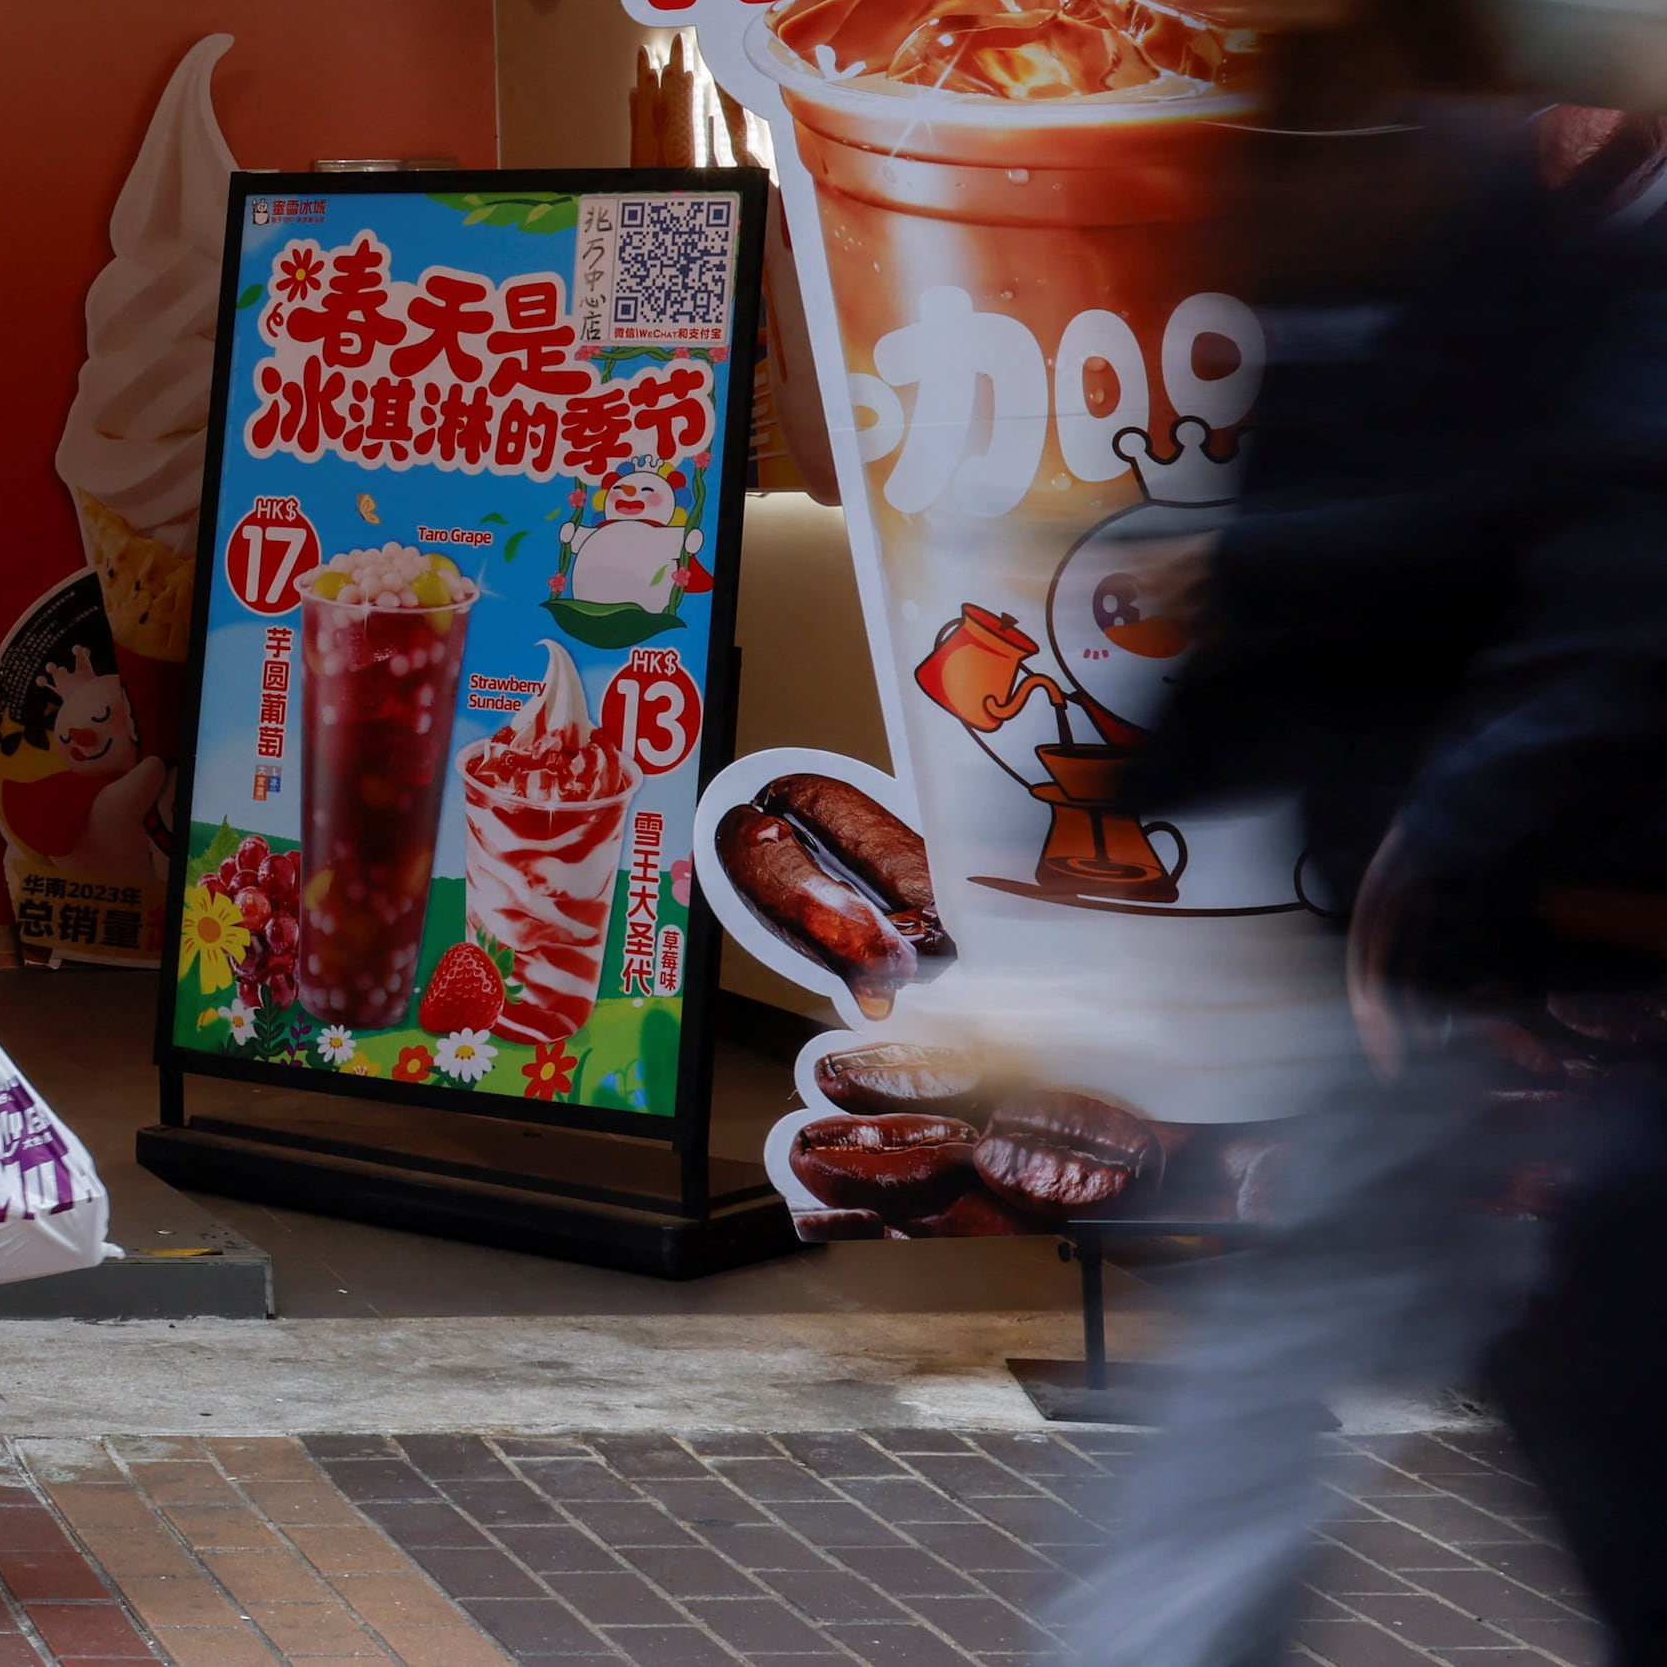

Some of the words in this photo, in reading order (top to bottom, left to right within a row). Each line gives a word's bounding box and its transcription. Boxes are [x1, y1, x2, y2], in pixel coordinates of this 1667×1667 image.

[272, 199, 326, 216] 蜜雪冰城
[287, 238, 592, 397] 春天是
[252, 355, 706, 476] 冰淇淋的季节
[255, 497, 299, 521] HK$
[418, 527, 449, 543] Taro
[451, 528, 493, 547] Grape
[241, 526, 309, 604] 17
[470, 671, 546, 696] Strawberry
[632, 649, 680, 675] HK$
[257, 627, 293, 759] 芋圆葡萄
[468, 694, 522, 712] Sundae
[617, 678, 685, 768] 13
[23, 874, 142, 907] 华南2023年
[623, 811, 665, 996] 雪王大圣代
[18, 898, 142, 949] 总销量
[659, 929, 681, 992] 草莓味
